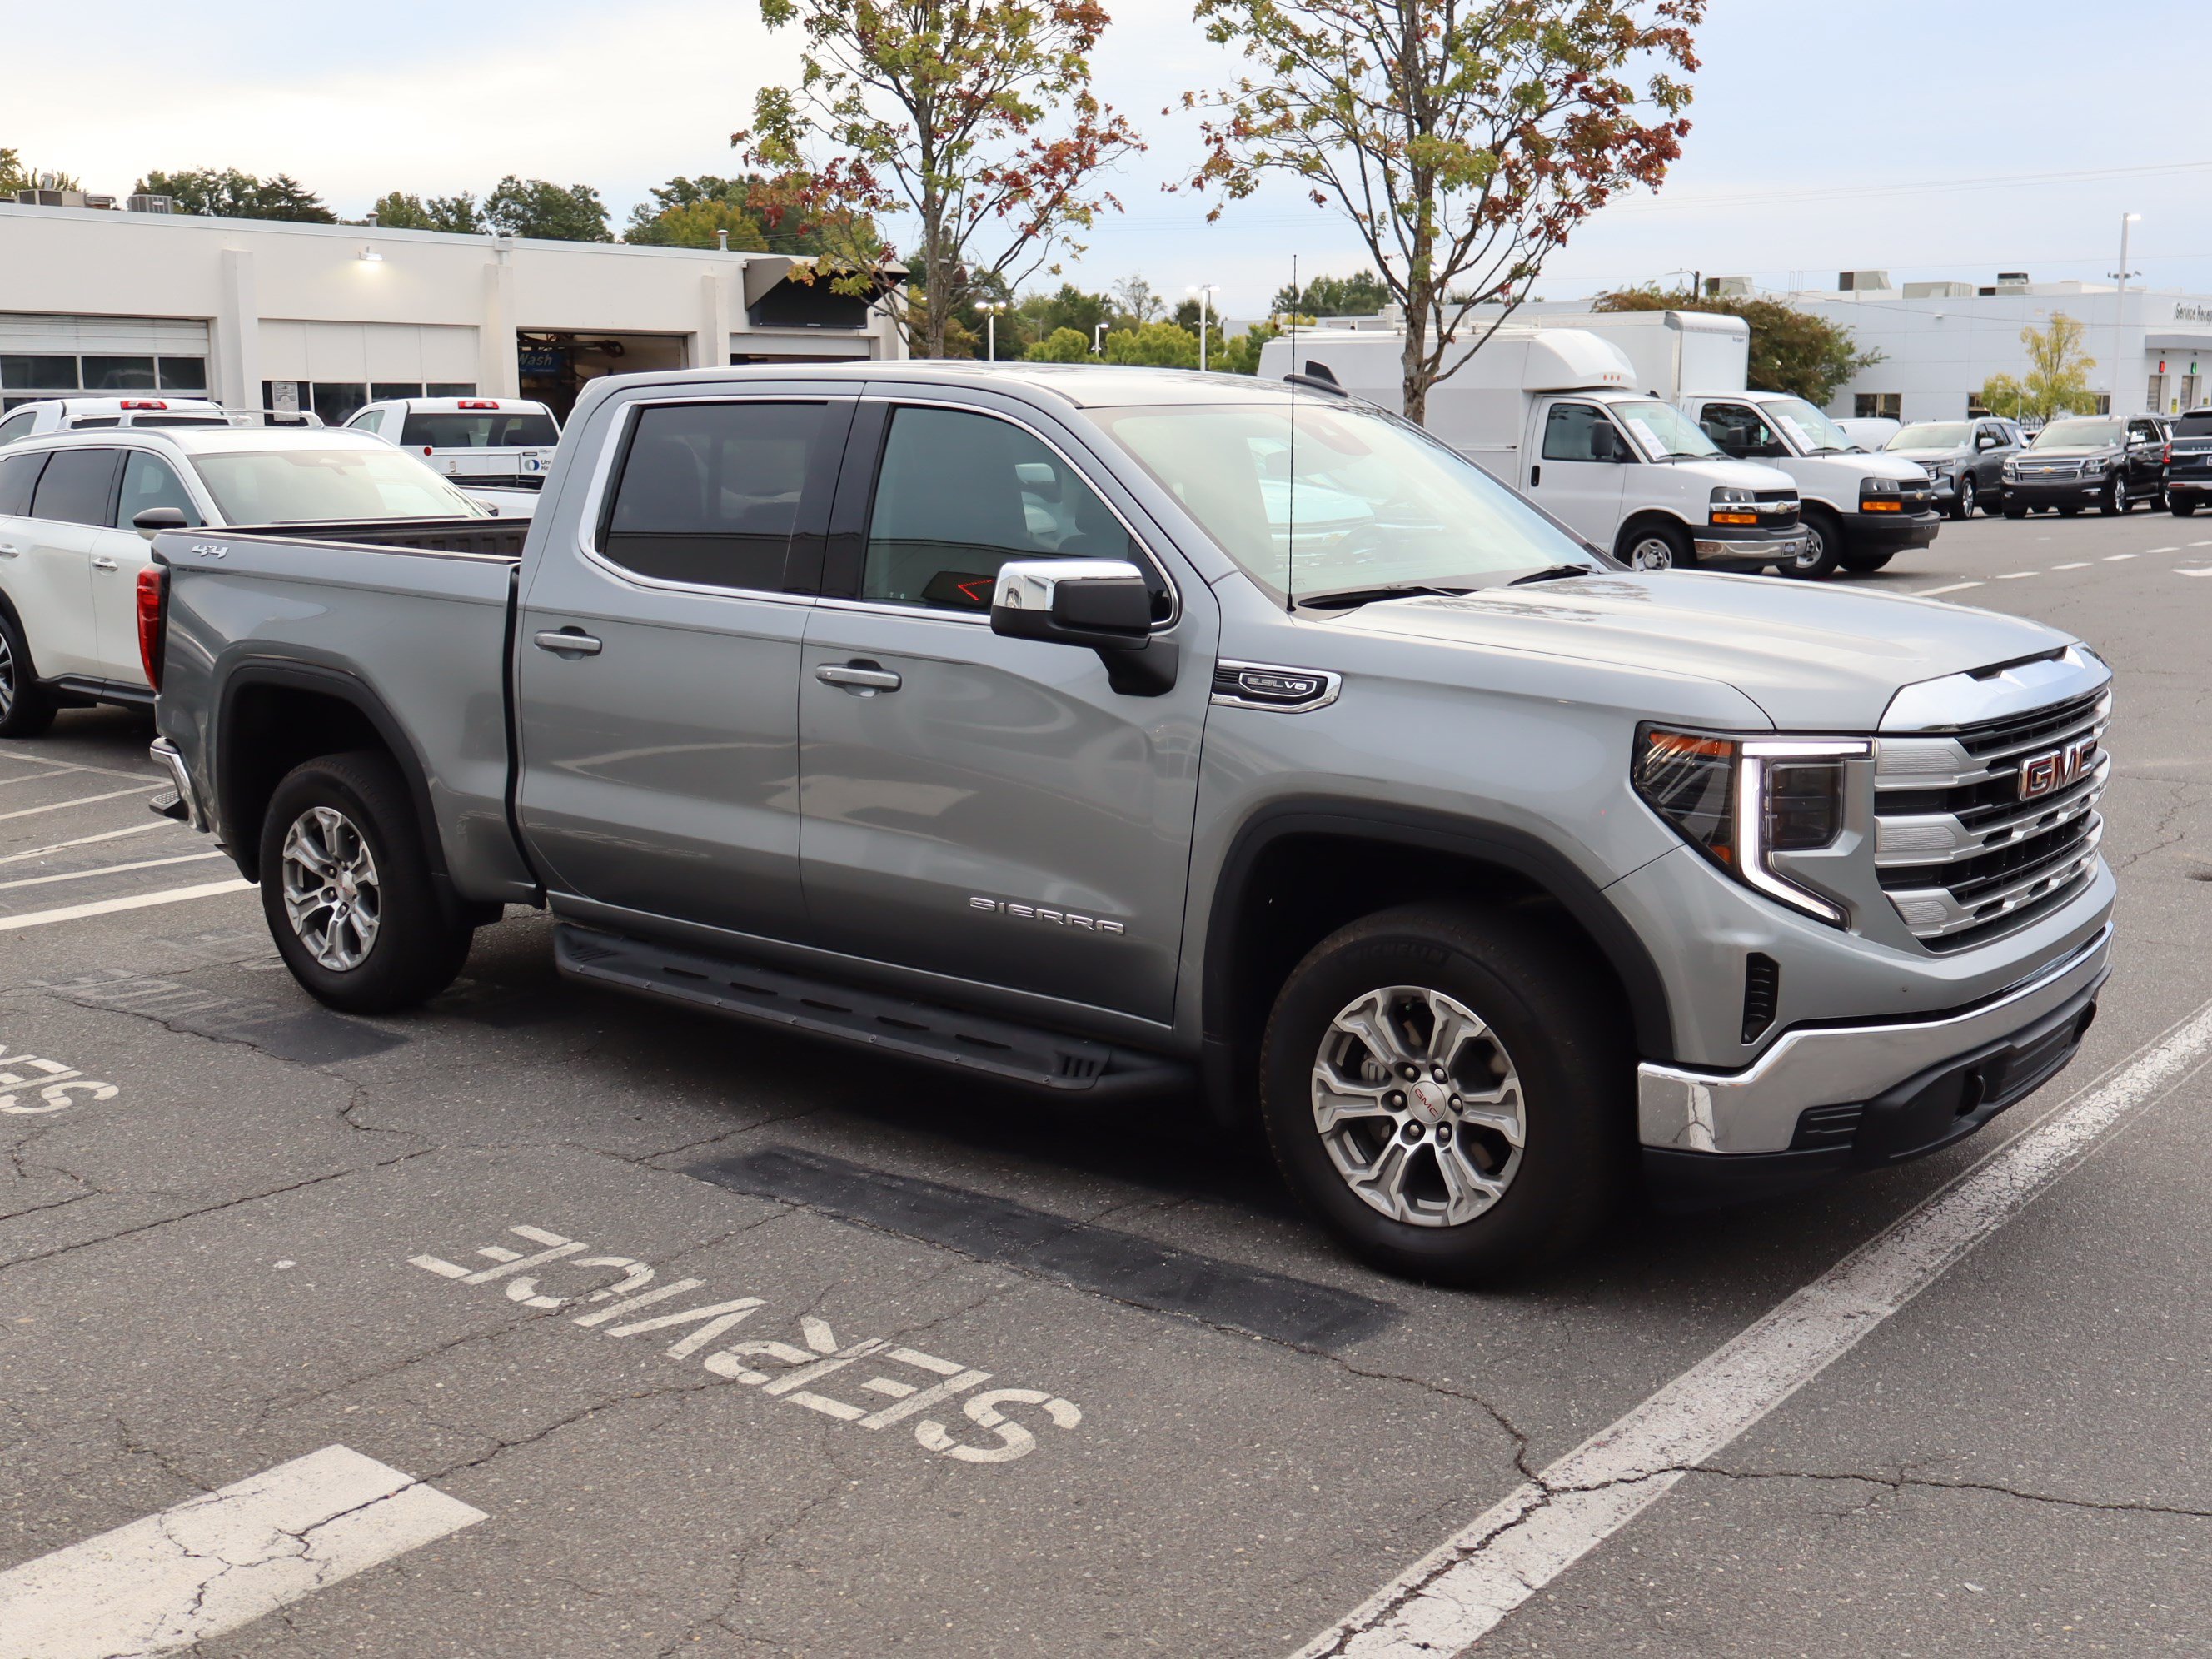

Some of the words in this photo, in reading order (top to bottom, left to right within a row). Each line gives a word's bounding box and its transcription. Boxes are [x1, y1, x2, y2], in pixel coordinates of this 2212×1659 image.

[2019, 736, 2095, 801] GMC
[969, 897, 1124, 935] SIERRA
[0, 1044, 119, 1114] SE
[1414, 1088, 1439, 1118] GMC
[407, 1225, 1084, 1463] SERVICE
